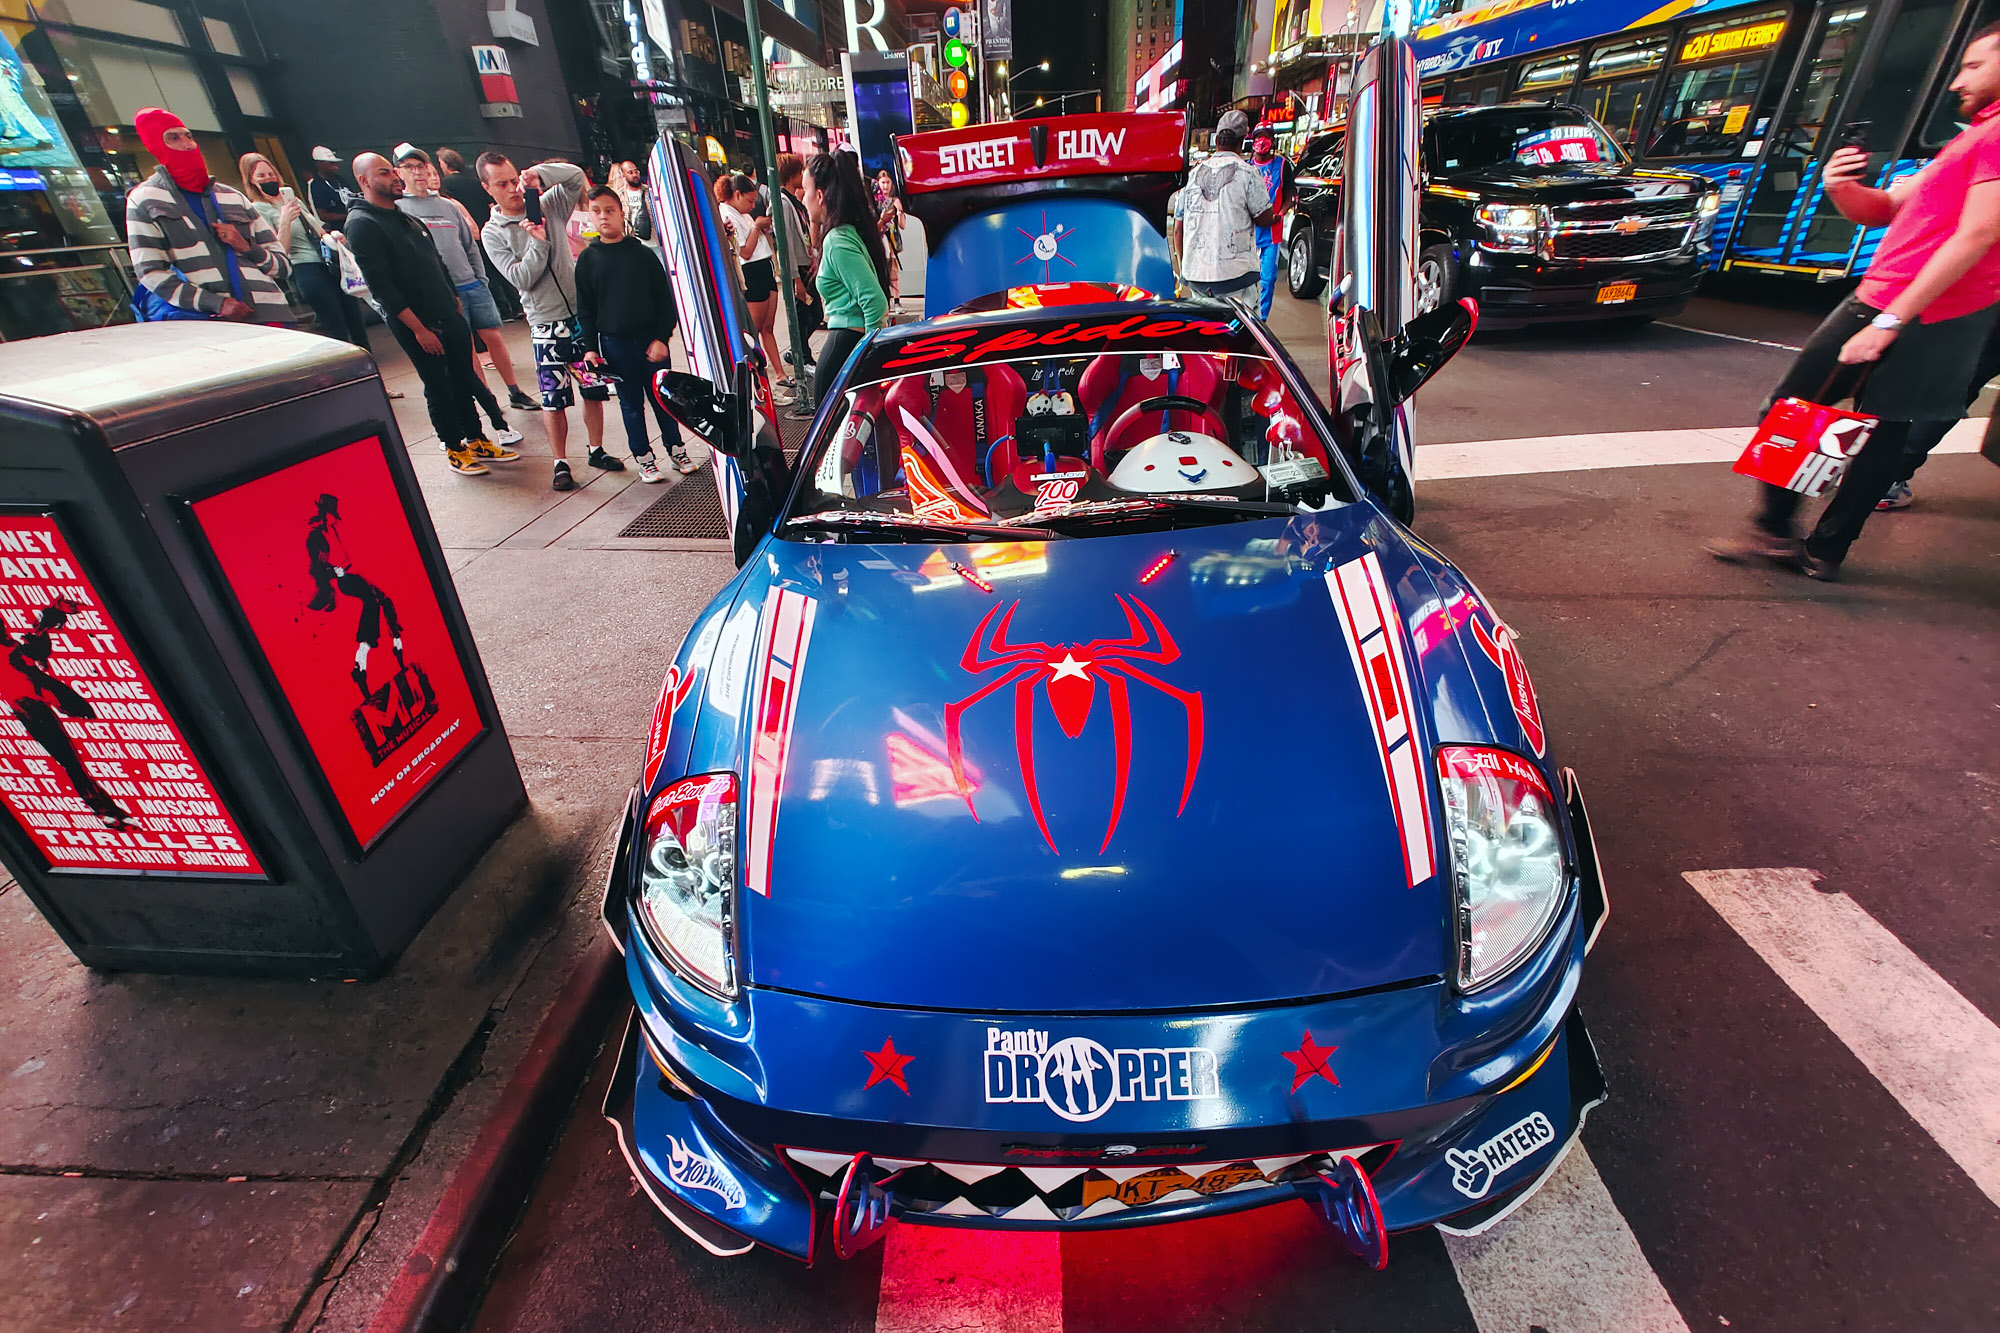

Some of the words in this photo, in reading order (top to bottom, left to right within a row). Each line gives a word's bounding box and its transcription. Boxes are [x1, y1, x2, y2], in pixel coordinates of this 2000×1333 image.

[624, 0, 650, 80] Lids
[1483, 38, 1504, 58] NY
[1267, 108, 1295, 122] NYC
[939, 136, 1018, 175] STREET
[1058, 127, 1127, 160] GLOW
[882, 315, 1236, 369] Spider
[974, 399, 986, 441] TANAKA
[1053, 470, 1086, 479] GLOW
[1036, 480, 1078, 506] 100
[0, 530, 57, 553] NEY
[13, 584, 51, 606] YOU
[88, 633, 118, 653] IT
[48, 658, 107, 677] ABOUT
[107, 659, 137, 678] US
[70, 680, 150, 699] CHINE
[89, 701, 164, 720] IRROR
[360, 668, 427, 748] MJ
[63, 722, 87, 739] OU
[84, 722, 116, 739] GET
[113, 723, 177, 741] ENOUGH
[377, 740, 396, 758] THE
[396, 711, 432, 744] MUSICAL
[83, 742, 129, 759] BLACK
[125, 743, 147, 760] OR
[143, 744, 188, 761] WHITE
[370, 779, 396, 805] NOW
[396, 764, 411, 781] ON
[411, 718, 460, 767] BROADWAY
[22, 759, 55, 775] BE
[84, 761, 129, 778] ERE
[147, 763, 197, 780] ABC
[0, 776, 40, 793] BEAT
[40, 777, 62, 794] IT
[97, 780, 140, 796] MAN
[139, 781, 211, 798] NATURE
[8, 794, 95, 813] STRANGE
[136, 799, 219, 816] MOSCOW
[20, 812, 71, 828] TABLOID
[143, 817, 178, 832] LOVE
[173, 818, 202, 833] YOU
[199, 819, 233, 834] SAVE
[34, 829, 242, 851] THRILLER
[46, 846, 100, 861] WANNA
[96, 848, 120, 863] BE
[117, 848, 176, 865] STARTIN'
[178, 851, 250, 867] SOMETHIN'
[987, 1027, 1049, 1055] Panty
[1483, 1116, 1550, 1170] HATERS
